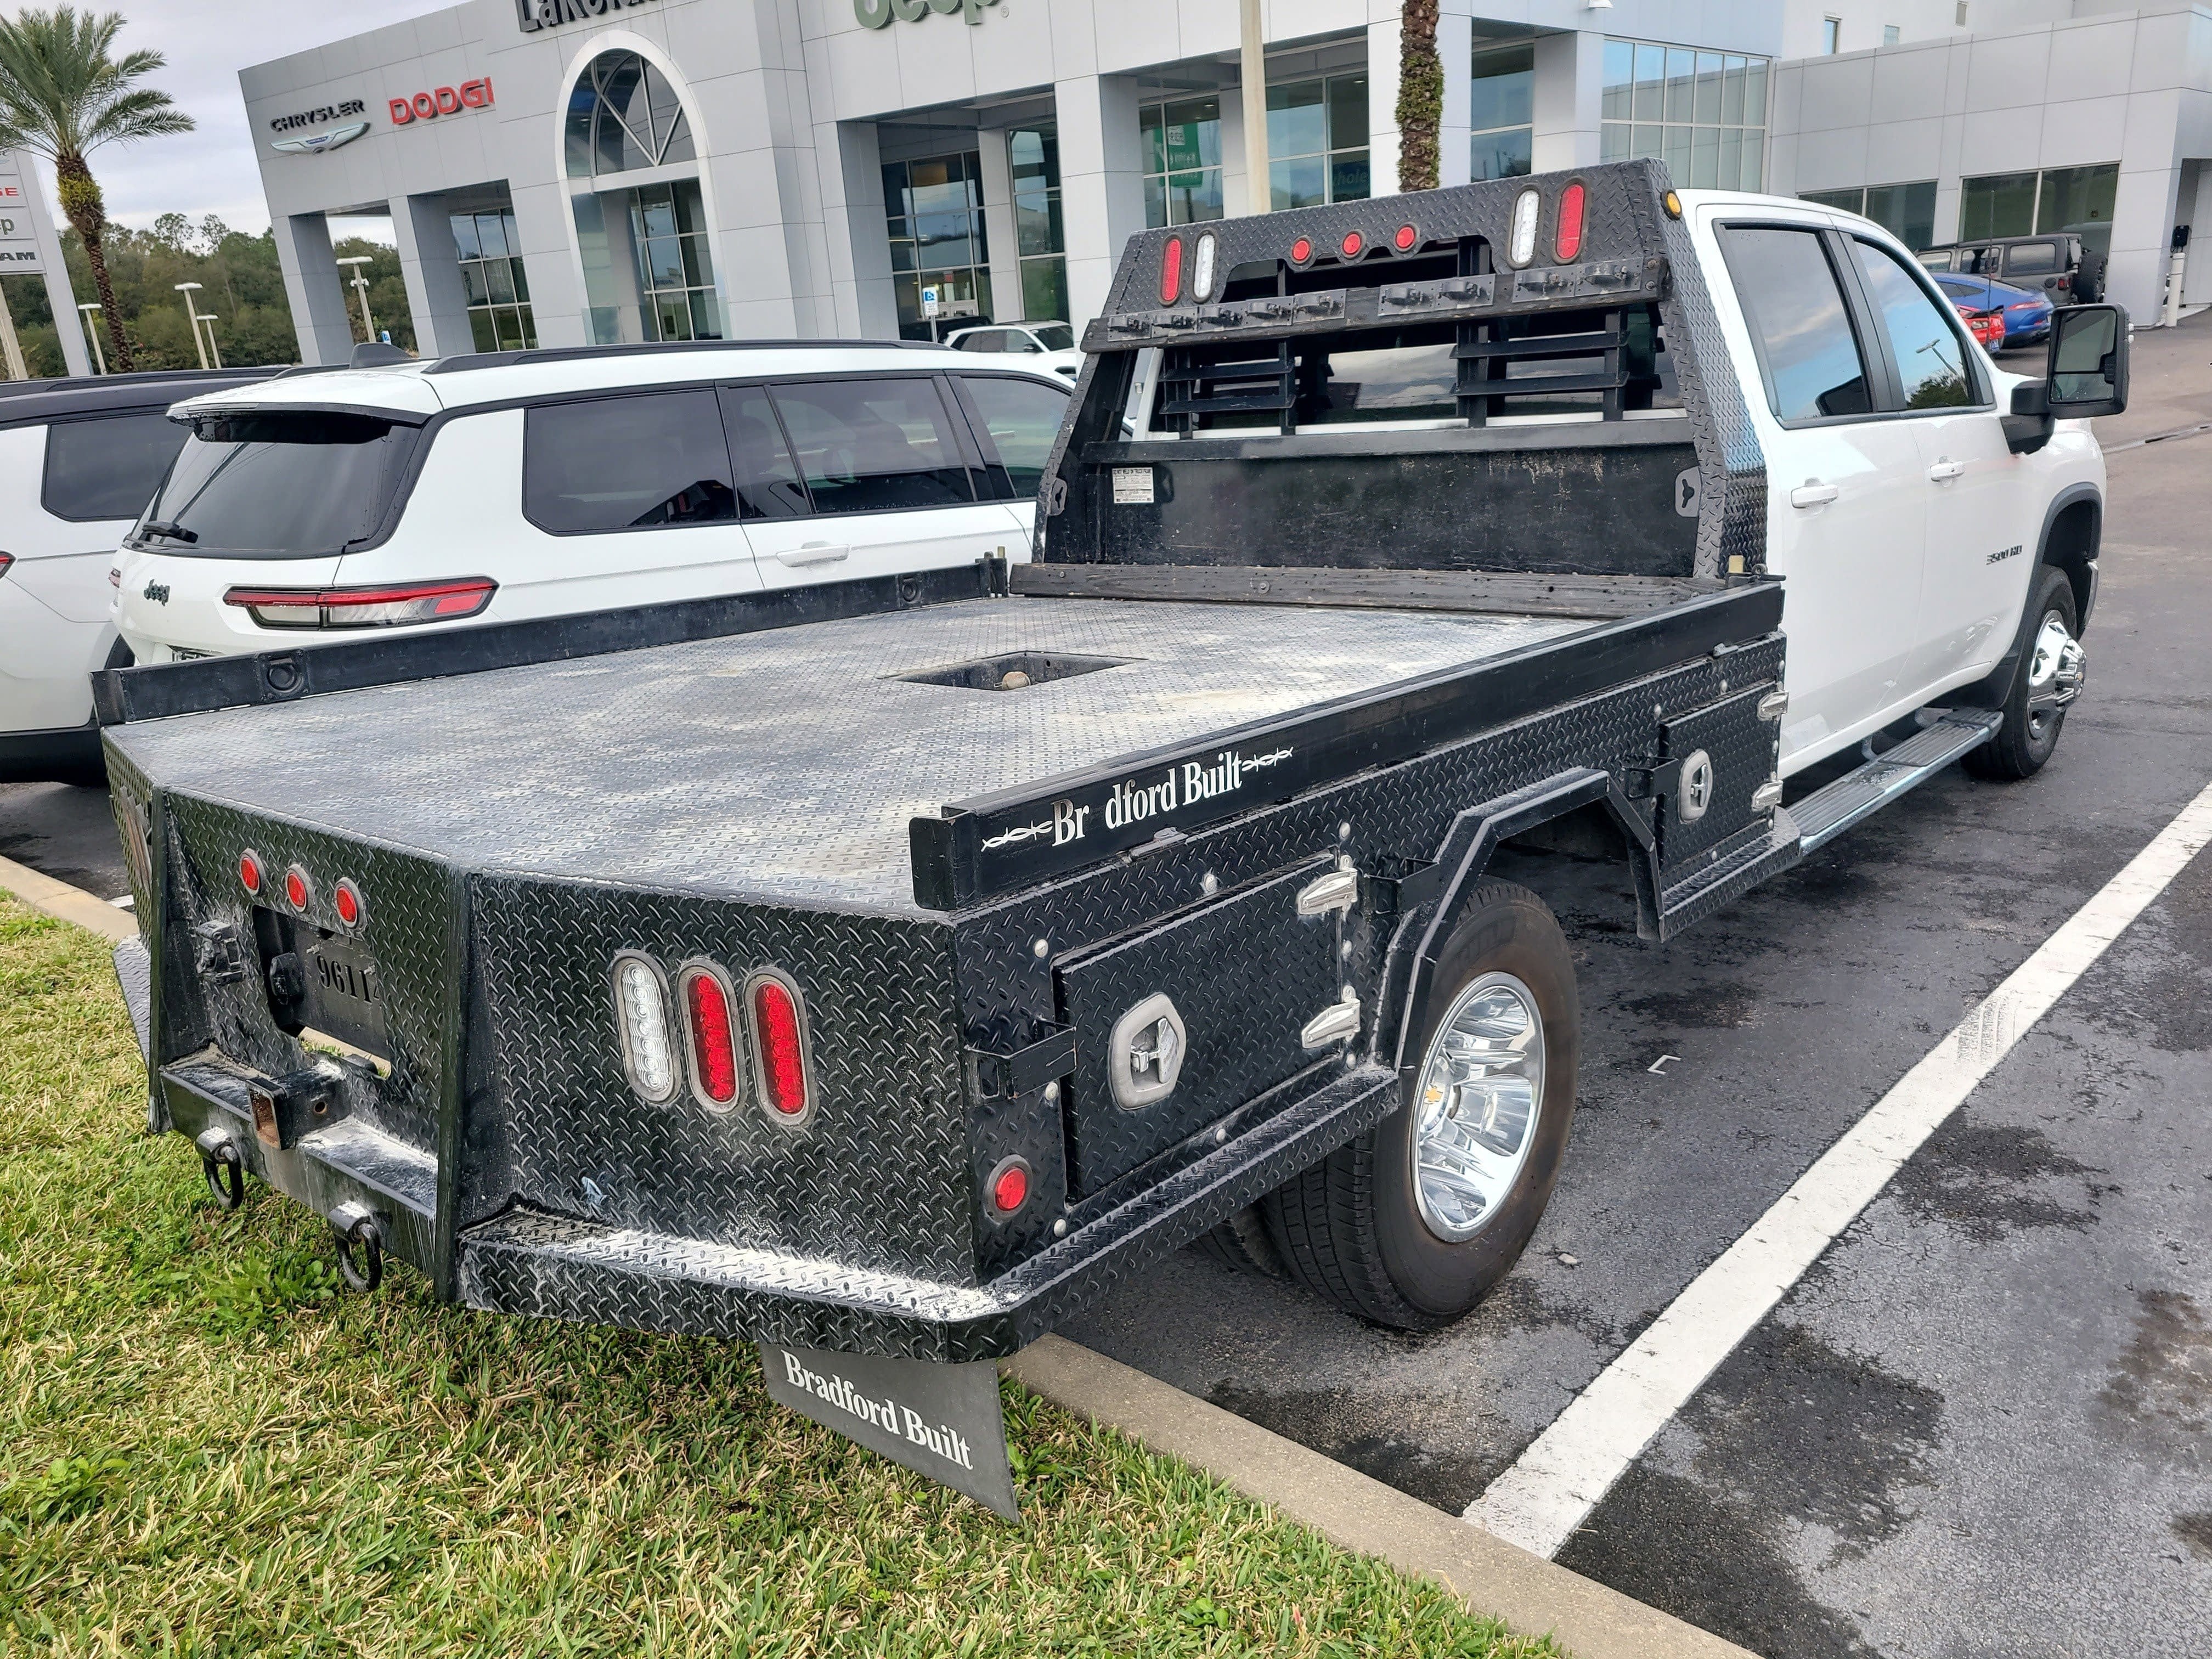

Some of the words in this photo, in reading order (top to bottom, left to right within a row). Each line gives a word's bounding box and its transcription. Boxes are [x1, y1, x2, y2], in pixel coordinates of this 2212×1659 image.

[269, 100, 365, 132] CHRYSLER
[2010, 544, 2023, 557] HD
[143, 578, 171, 607] Jeep
[1181, 751, 1243, 806] Built
[316, 955, 380, 1005] 9611
[780, 1348, 901, 1436] Bradford
[899, 1404, 974, 1470] Built
